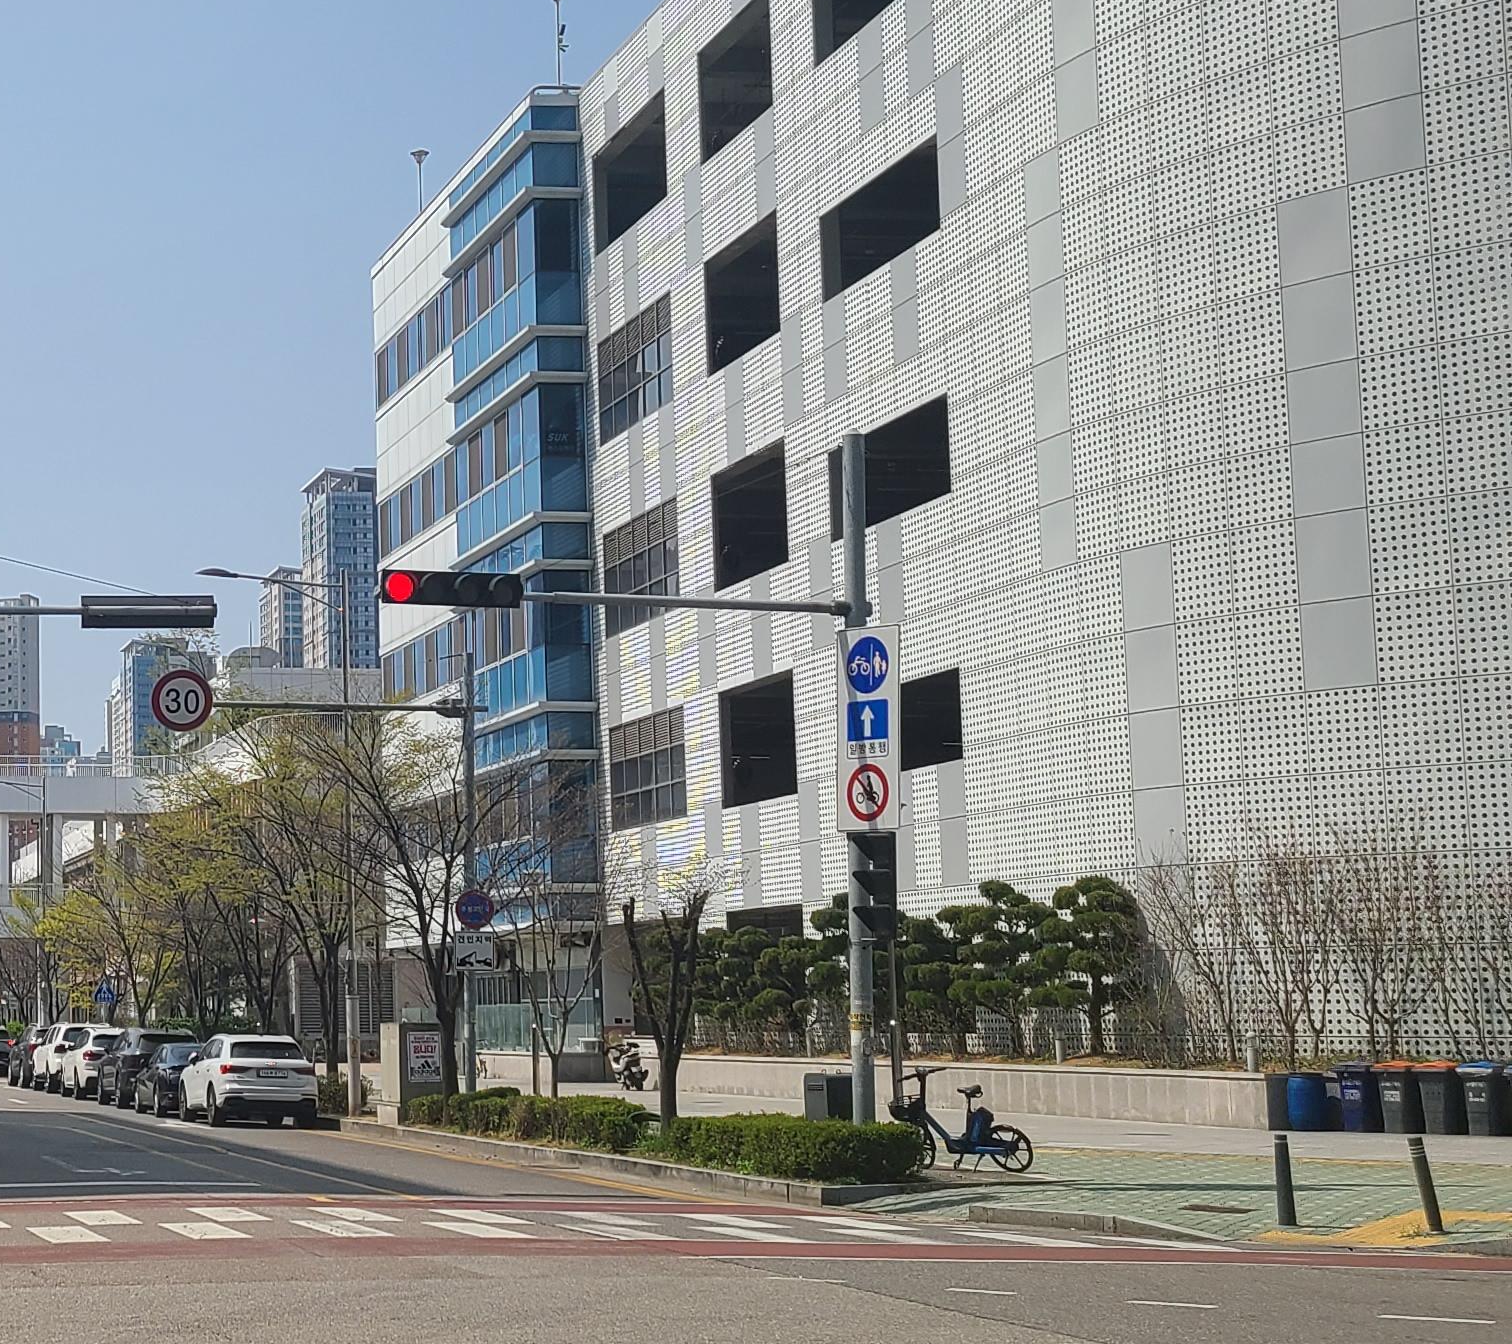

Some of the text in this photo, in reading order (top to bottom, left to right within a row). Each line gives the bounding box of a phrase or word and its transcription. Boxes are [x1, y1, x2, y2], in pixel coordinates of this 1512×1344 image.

[164, 687, 200, 715] 30
[849, 741, 887, 756] 일방통행
[457, 935, 492, 945] 견인지역
